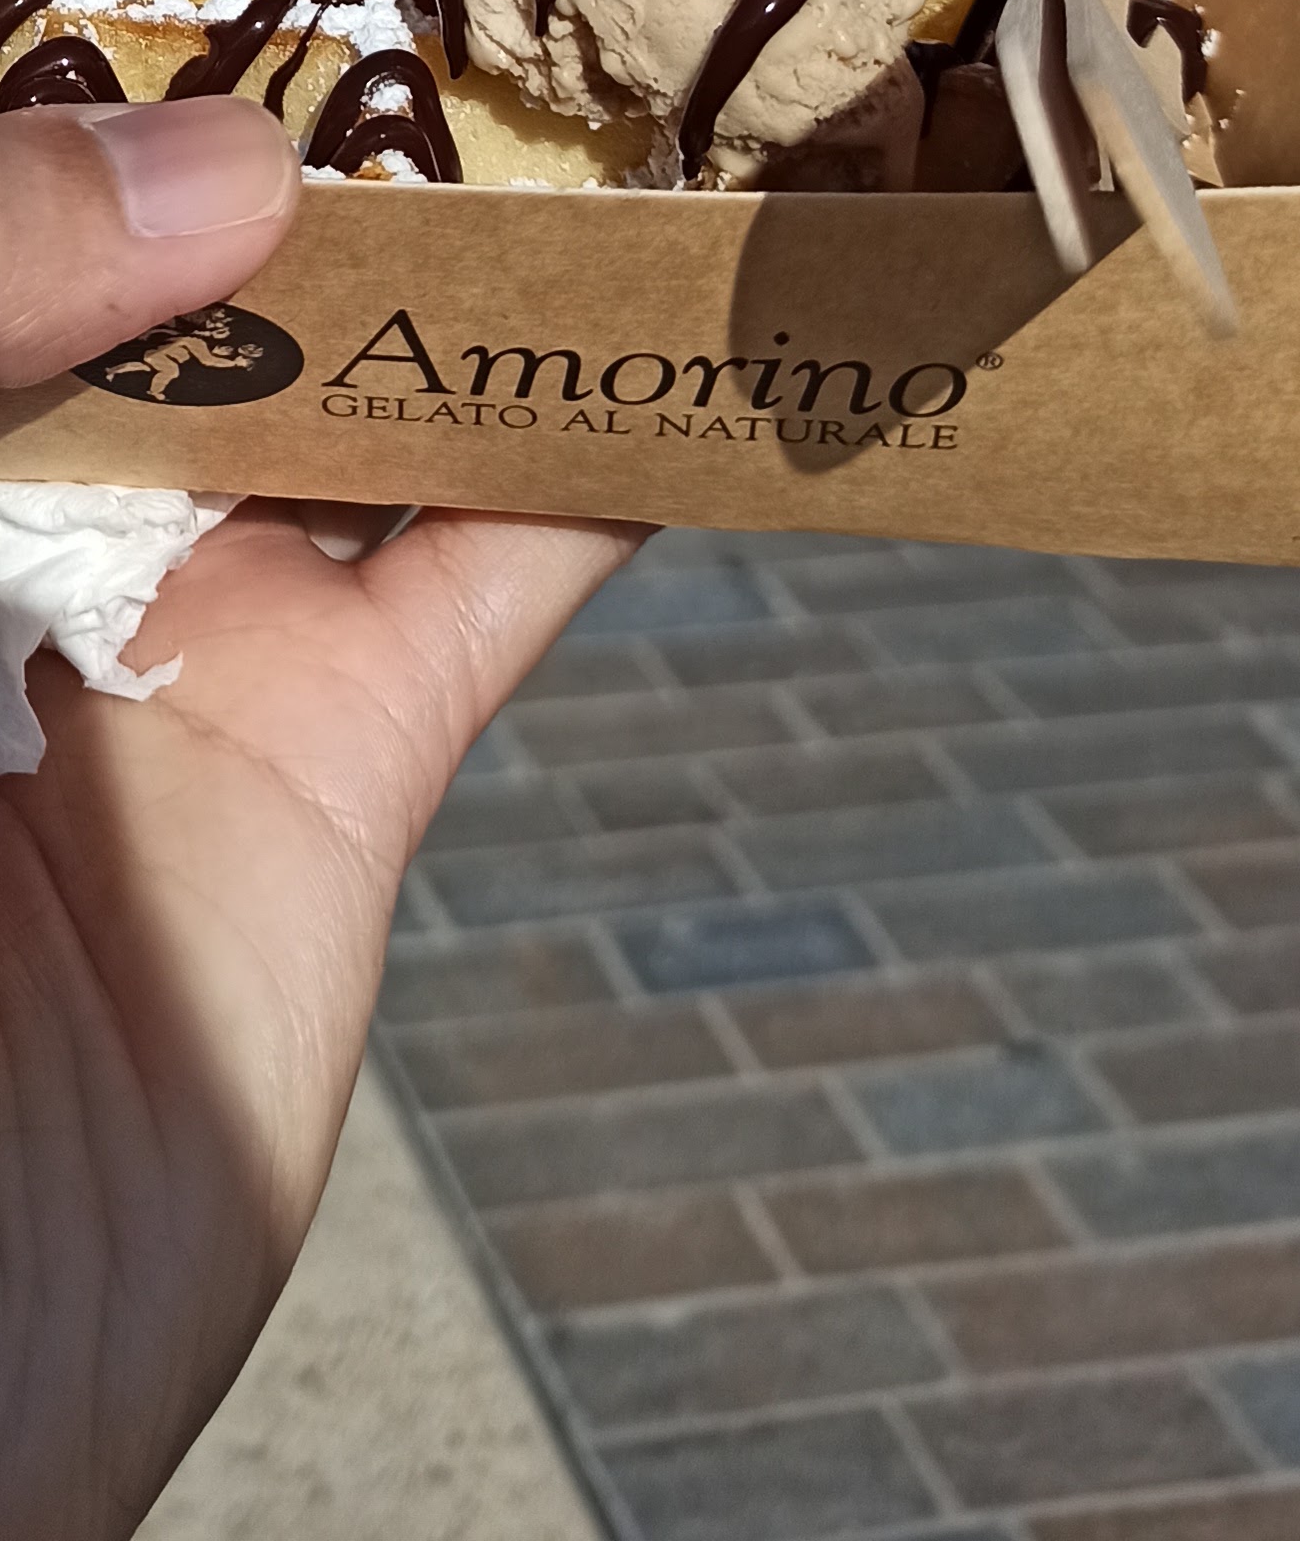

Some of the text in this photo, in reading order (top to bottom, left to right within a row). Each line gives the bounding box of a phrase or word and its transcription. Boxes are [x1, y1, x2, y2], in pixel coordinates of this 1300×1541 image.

[320, 393, 960, 451] GELATO AL NATURALE
